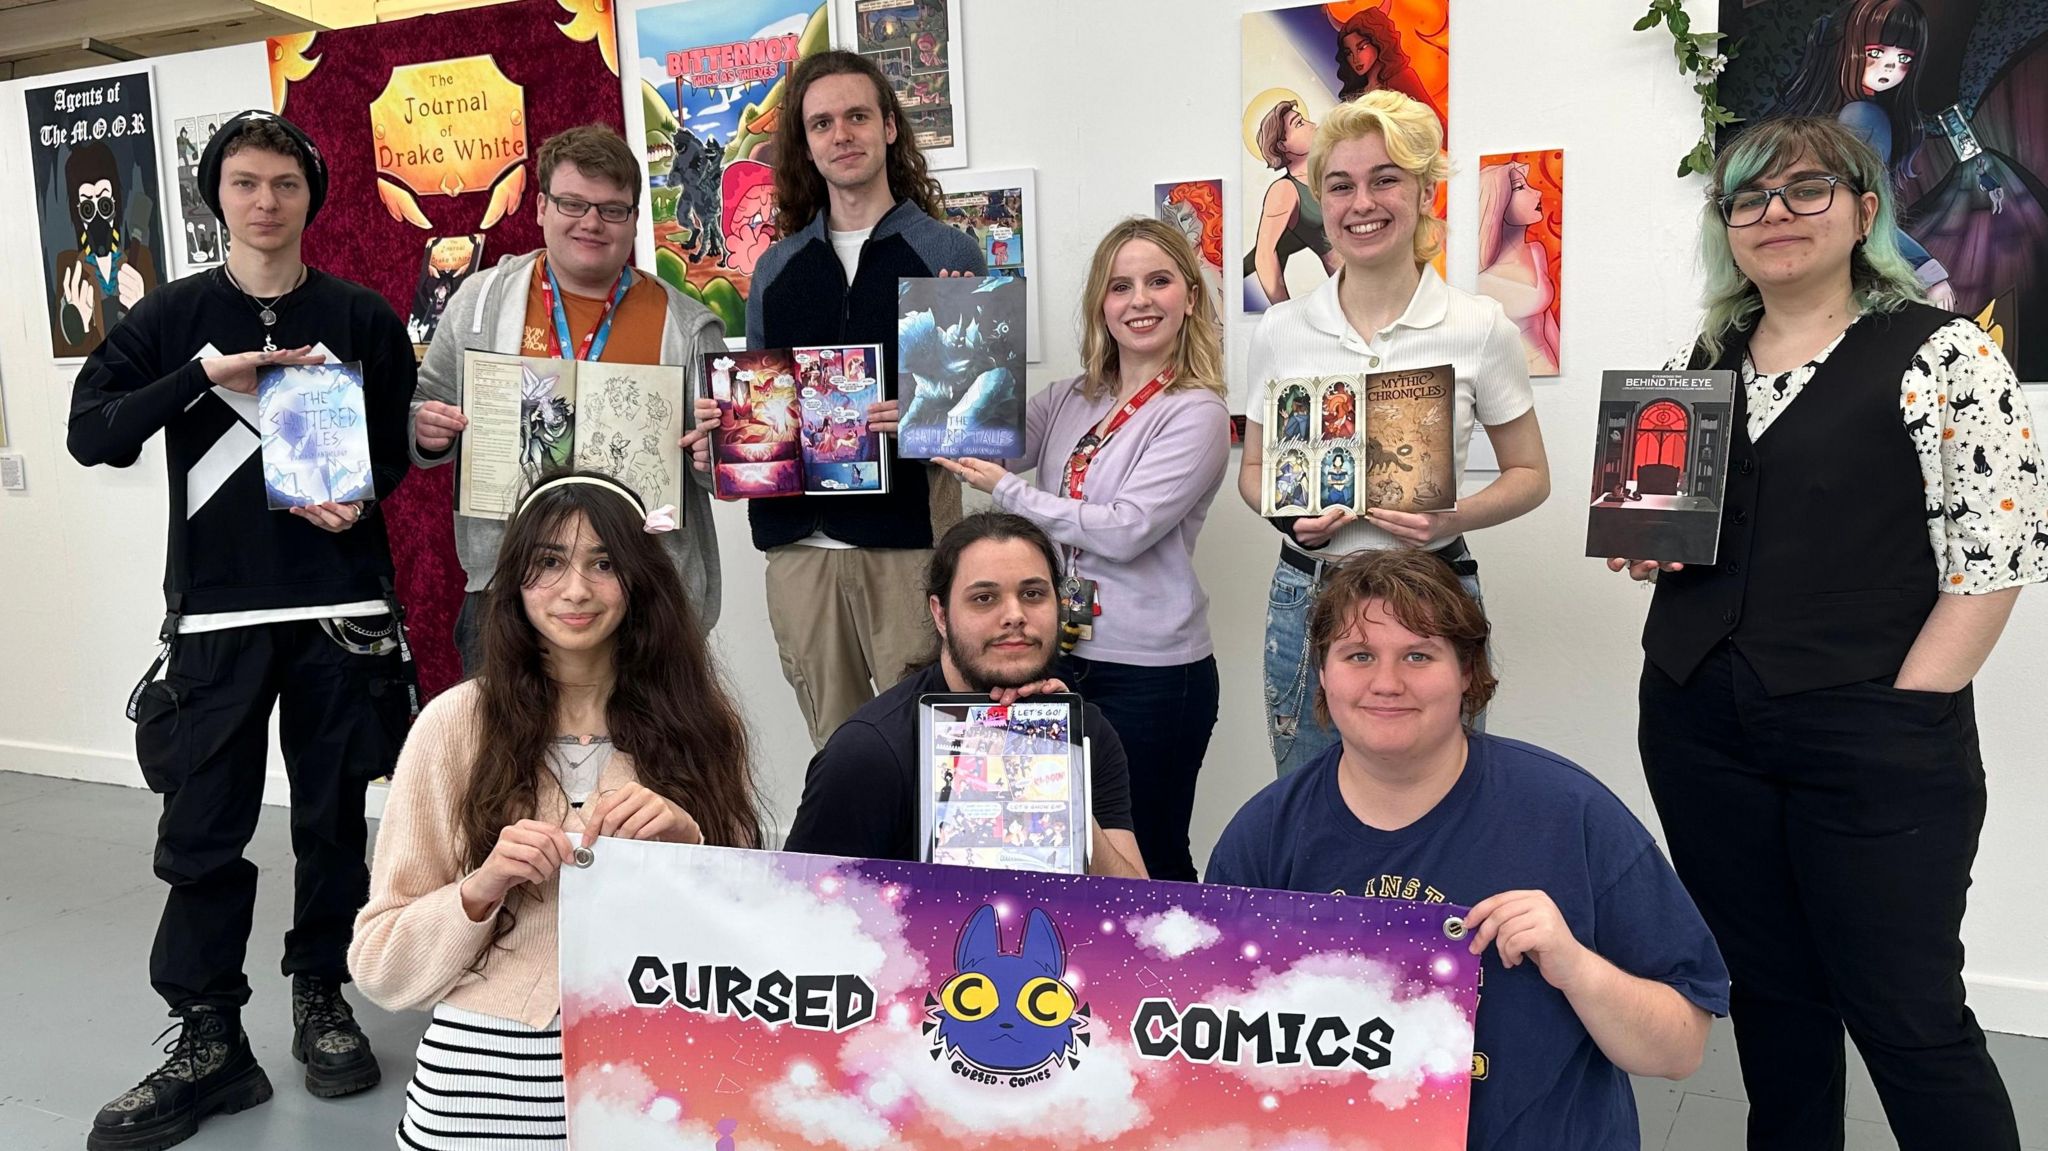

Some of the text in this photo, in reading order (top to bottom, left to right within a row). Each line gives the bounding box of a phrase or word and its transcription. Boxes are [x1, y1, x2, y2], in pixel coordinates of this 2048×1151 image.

[667, 35, 800, 77] BITTERNOX
[429, 74, 453, 87] The
[692, 65, 777, 87] THICK AS THIEVES
[54, 82, 120, 113] Agents of
[404, 91, 487, 124] Journal
[40, 113, 146, 148] The M.O.O.R
[440, 125, 452, 138] of
[379, 137, 524, 168] Drake White
[1368, 385, 1441, 402] CHRONICLES
[1381, 375, 1429, 390] MYTHIC
[1625, 378, 1712, 387] BEHIND THE EYE
[298, 391, 329, 406] THE
[949, 416, 968, 426] THE
[1017, 709, 1061, 717] LET'S GO!
[627, 956, 875, 1030] CURSED
[952, 977, 1058, 1022] C C
[1133, 1001, 1395, 1070] COMICS
[951, 1060, 997, 1085] CURSED
